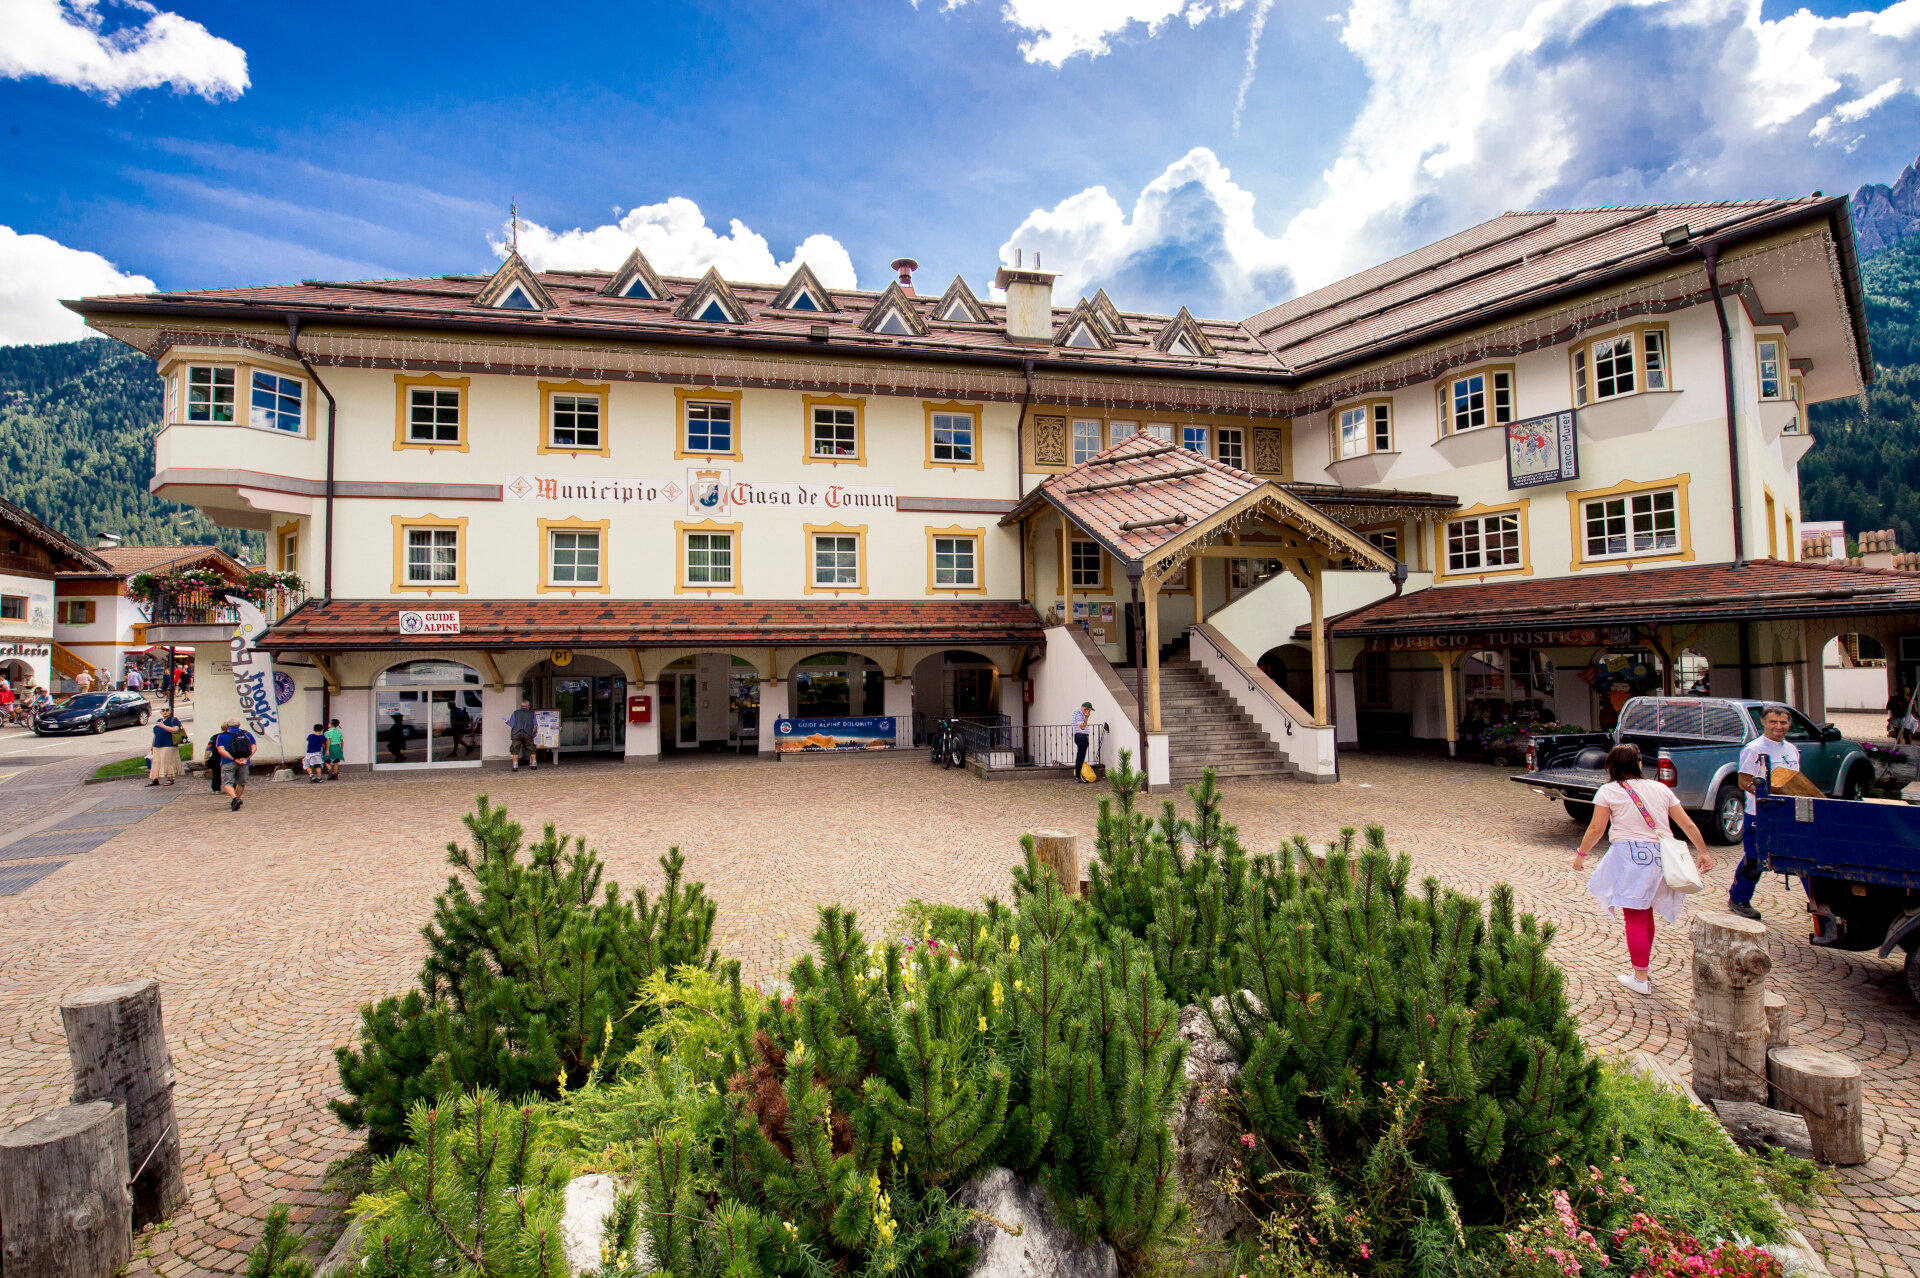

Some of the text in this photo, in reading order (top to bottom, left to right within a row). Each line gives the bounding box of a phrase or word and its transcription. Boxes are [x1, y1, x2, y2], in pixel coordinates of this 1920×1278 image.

[1562, 415, 1572, 476] Franco Murer
[534, 476, 657, 503] Municipio
[798, 484, 818, 506] de
[824, 485, 895, 508] Comun
[425, 613, 455, 621] GUIDE
[424, 623, 459, 632] ALPINE
[1394, 634, 1468, 648] UFFICIO
[1485, 629, 1595, 645] TURISTICO
[555, 651, 568, 661] PT
